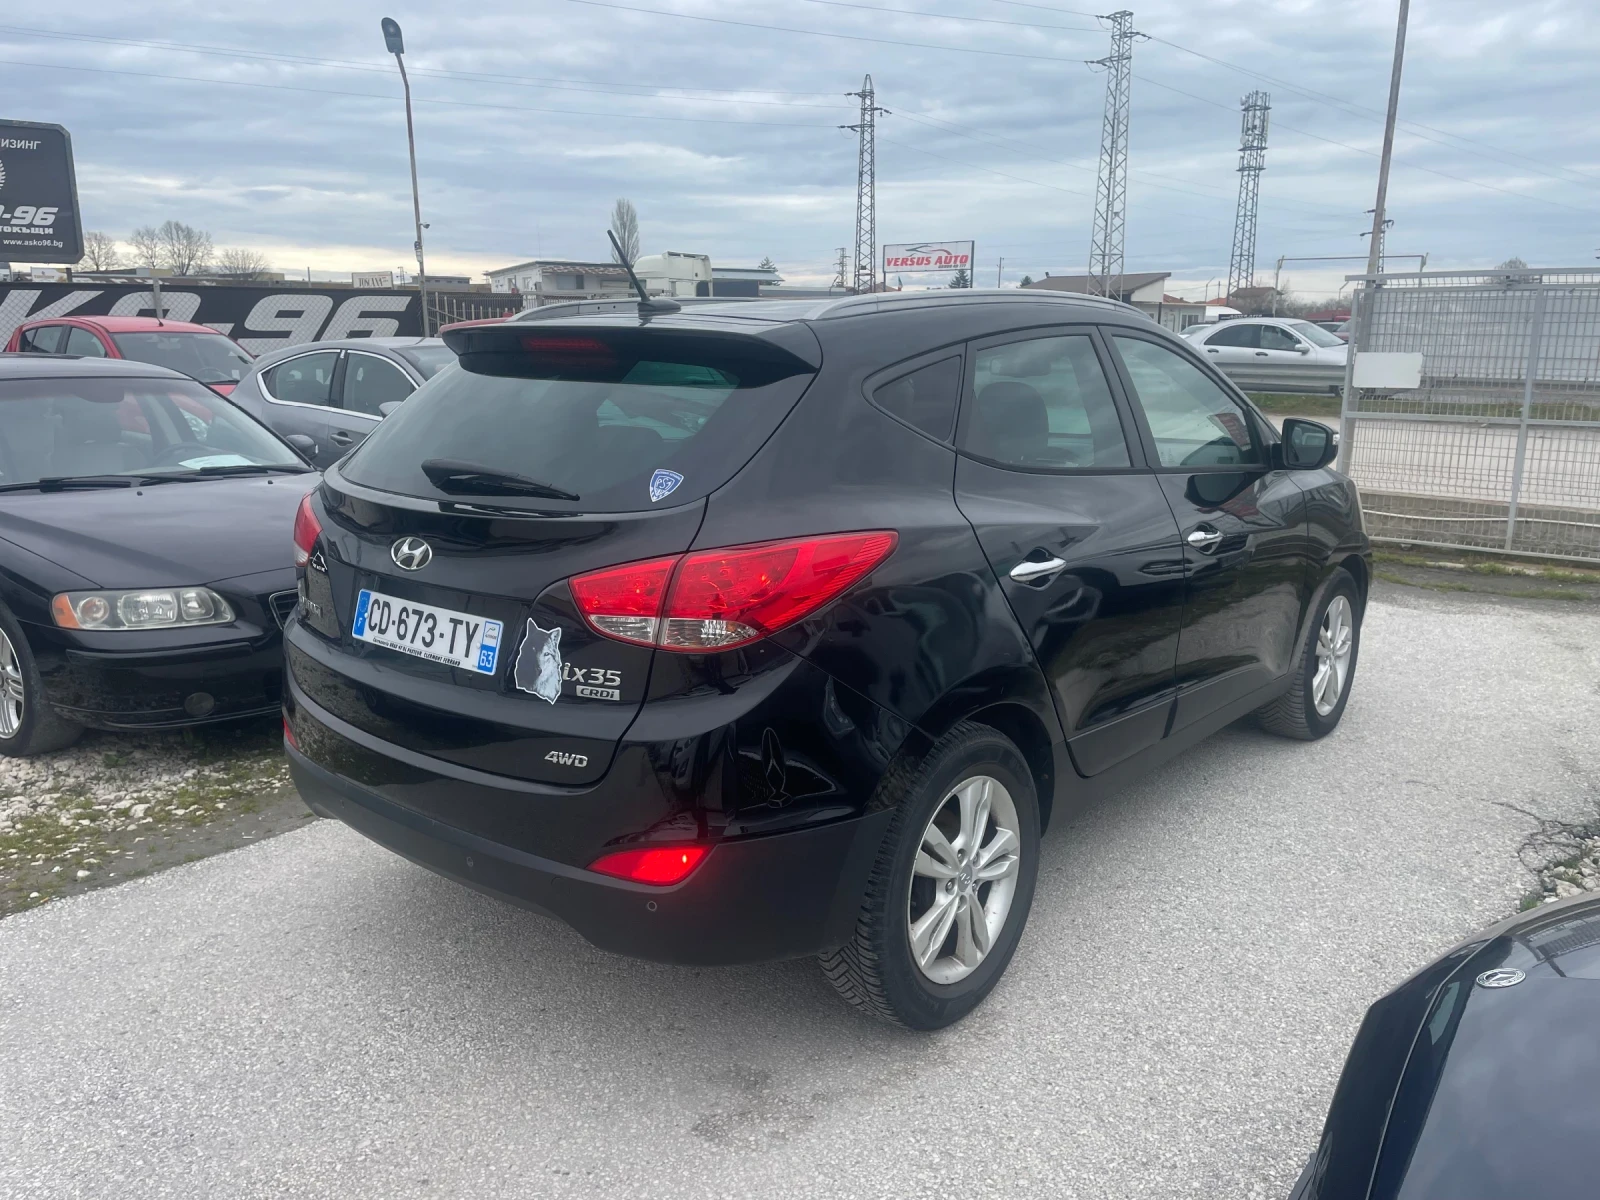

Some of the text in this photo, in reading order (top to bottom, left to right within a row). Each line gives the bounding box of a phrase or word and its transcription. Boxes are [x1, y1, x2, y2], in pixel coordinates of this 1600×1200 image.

[0, 204, 58, 225] -96
[3, 239, 63, 248] www.asko96.bg
[886, 255, 969, 266] VERSUS AUTO
[357, 617, 363, 627] F
[480, 650, 493, 668] 63
[562, 662, 622, 687] ix35
[580, 688, 615, 699] CRDi
[544, 751, 588, 768] 4WD
